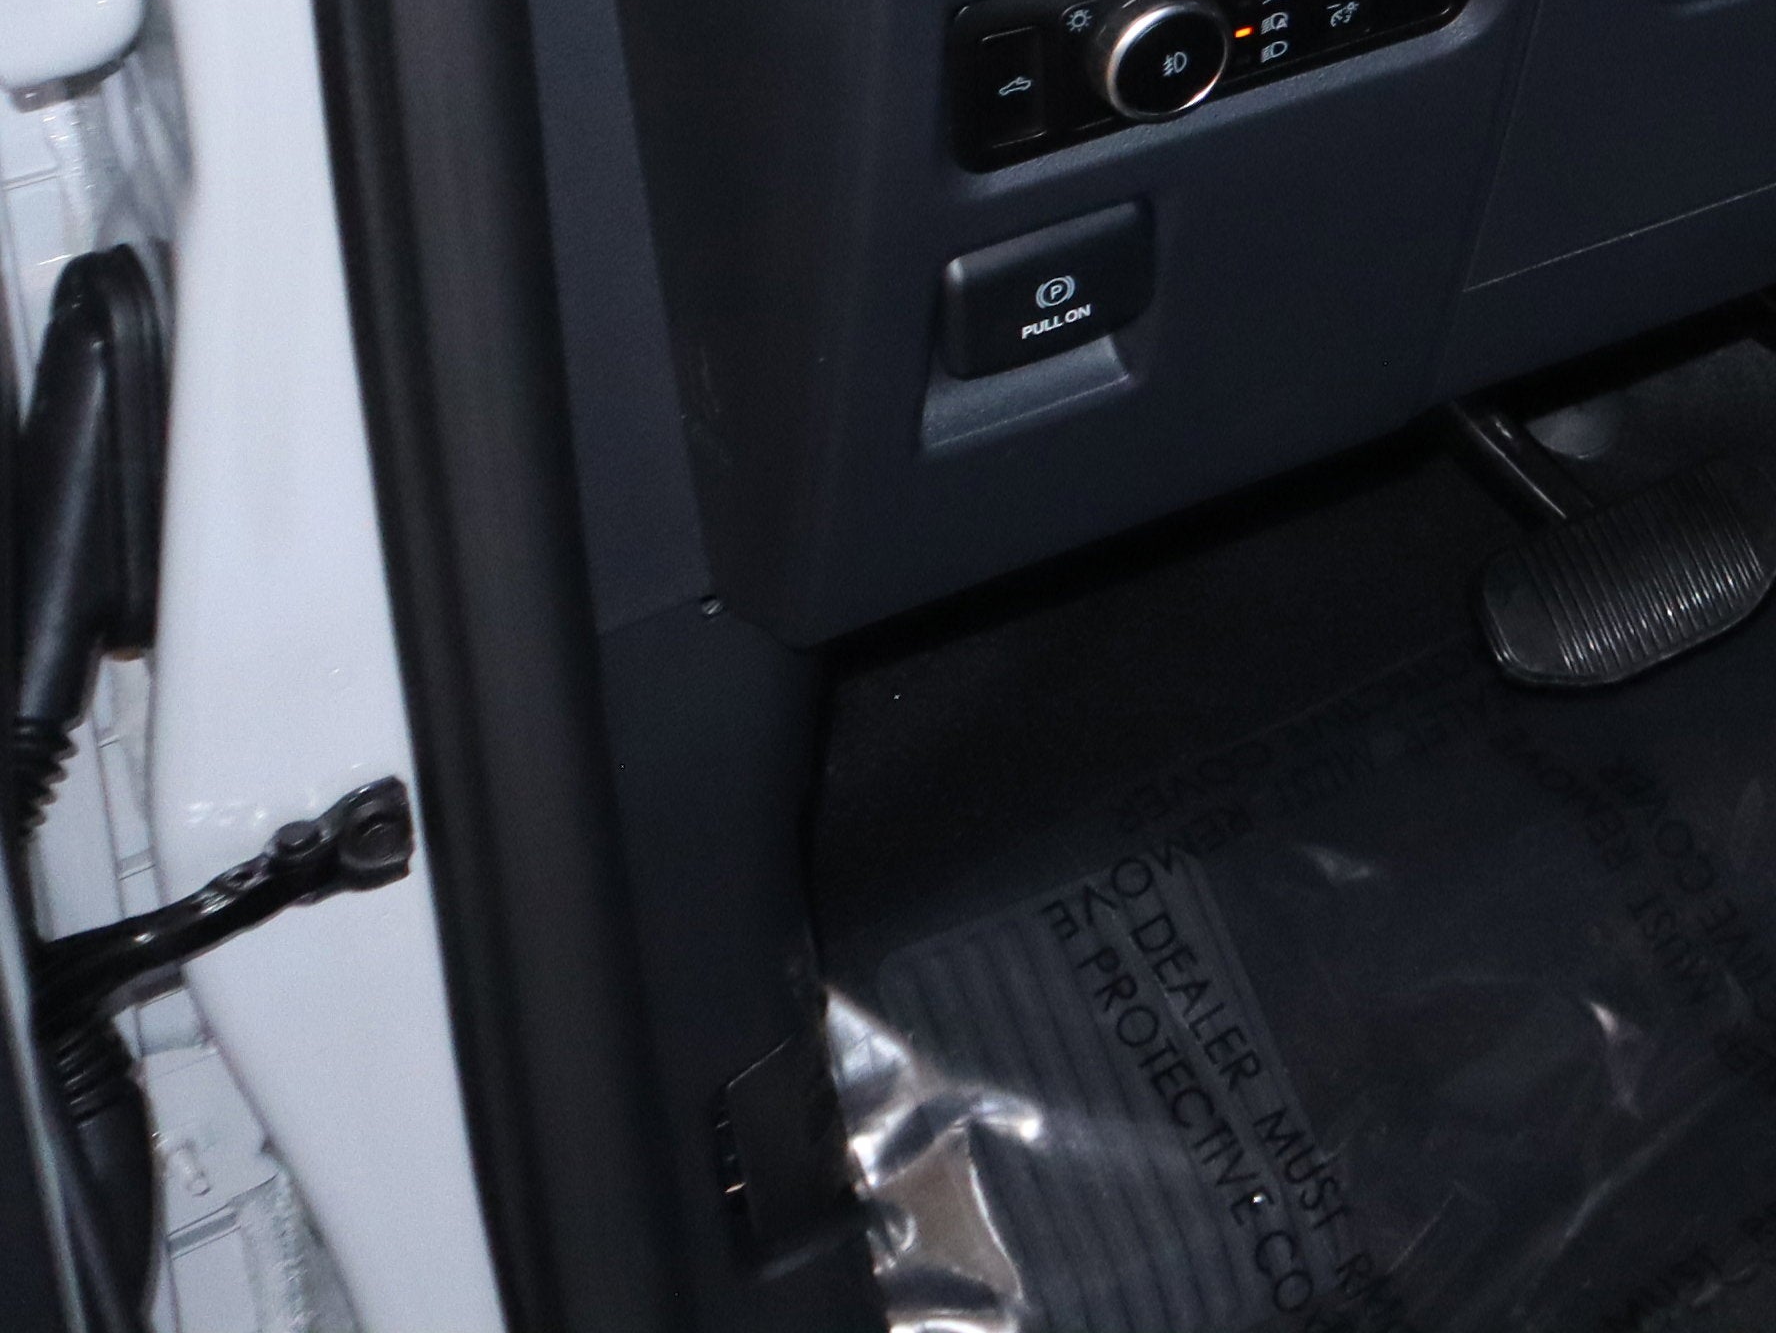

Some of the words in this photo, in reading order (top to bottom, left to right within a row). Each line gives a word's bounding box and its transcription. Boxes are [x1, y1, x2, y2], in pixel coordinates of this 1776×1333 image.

[1021, 315, 1064, 340] PULL
[1064, 303, 1091, 323] ON
[1076, 946, 1274, 1228] PROTECTIVE
[1133, 911, 1263, 1092] DEALER
[1252, 1106, 1352, 1230] MUST
